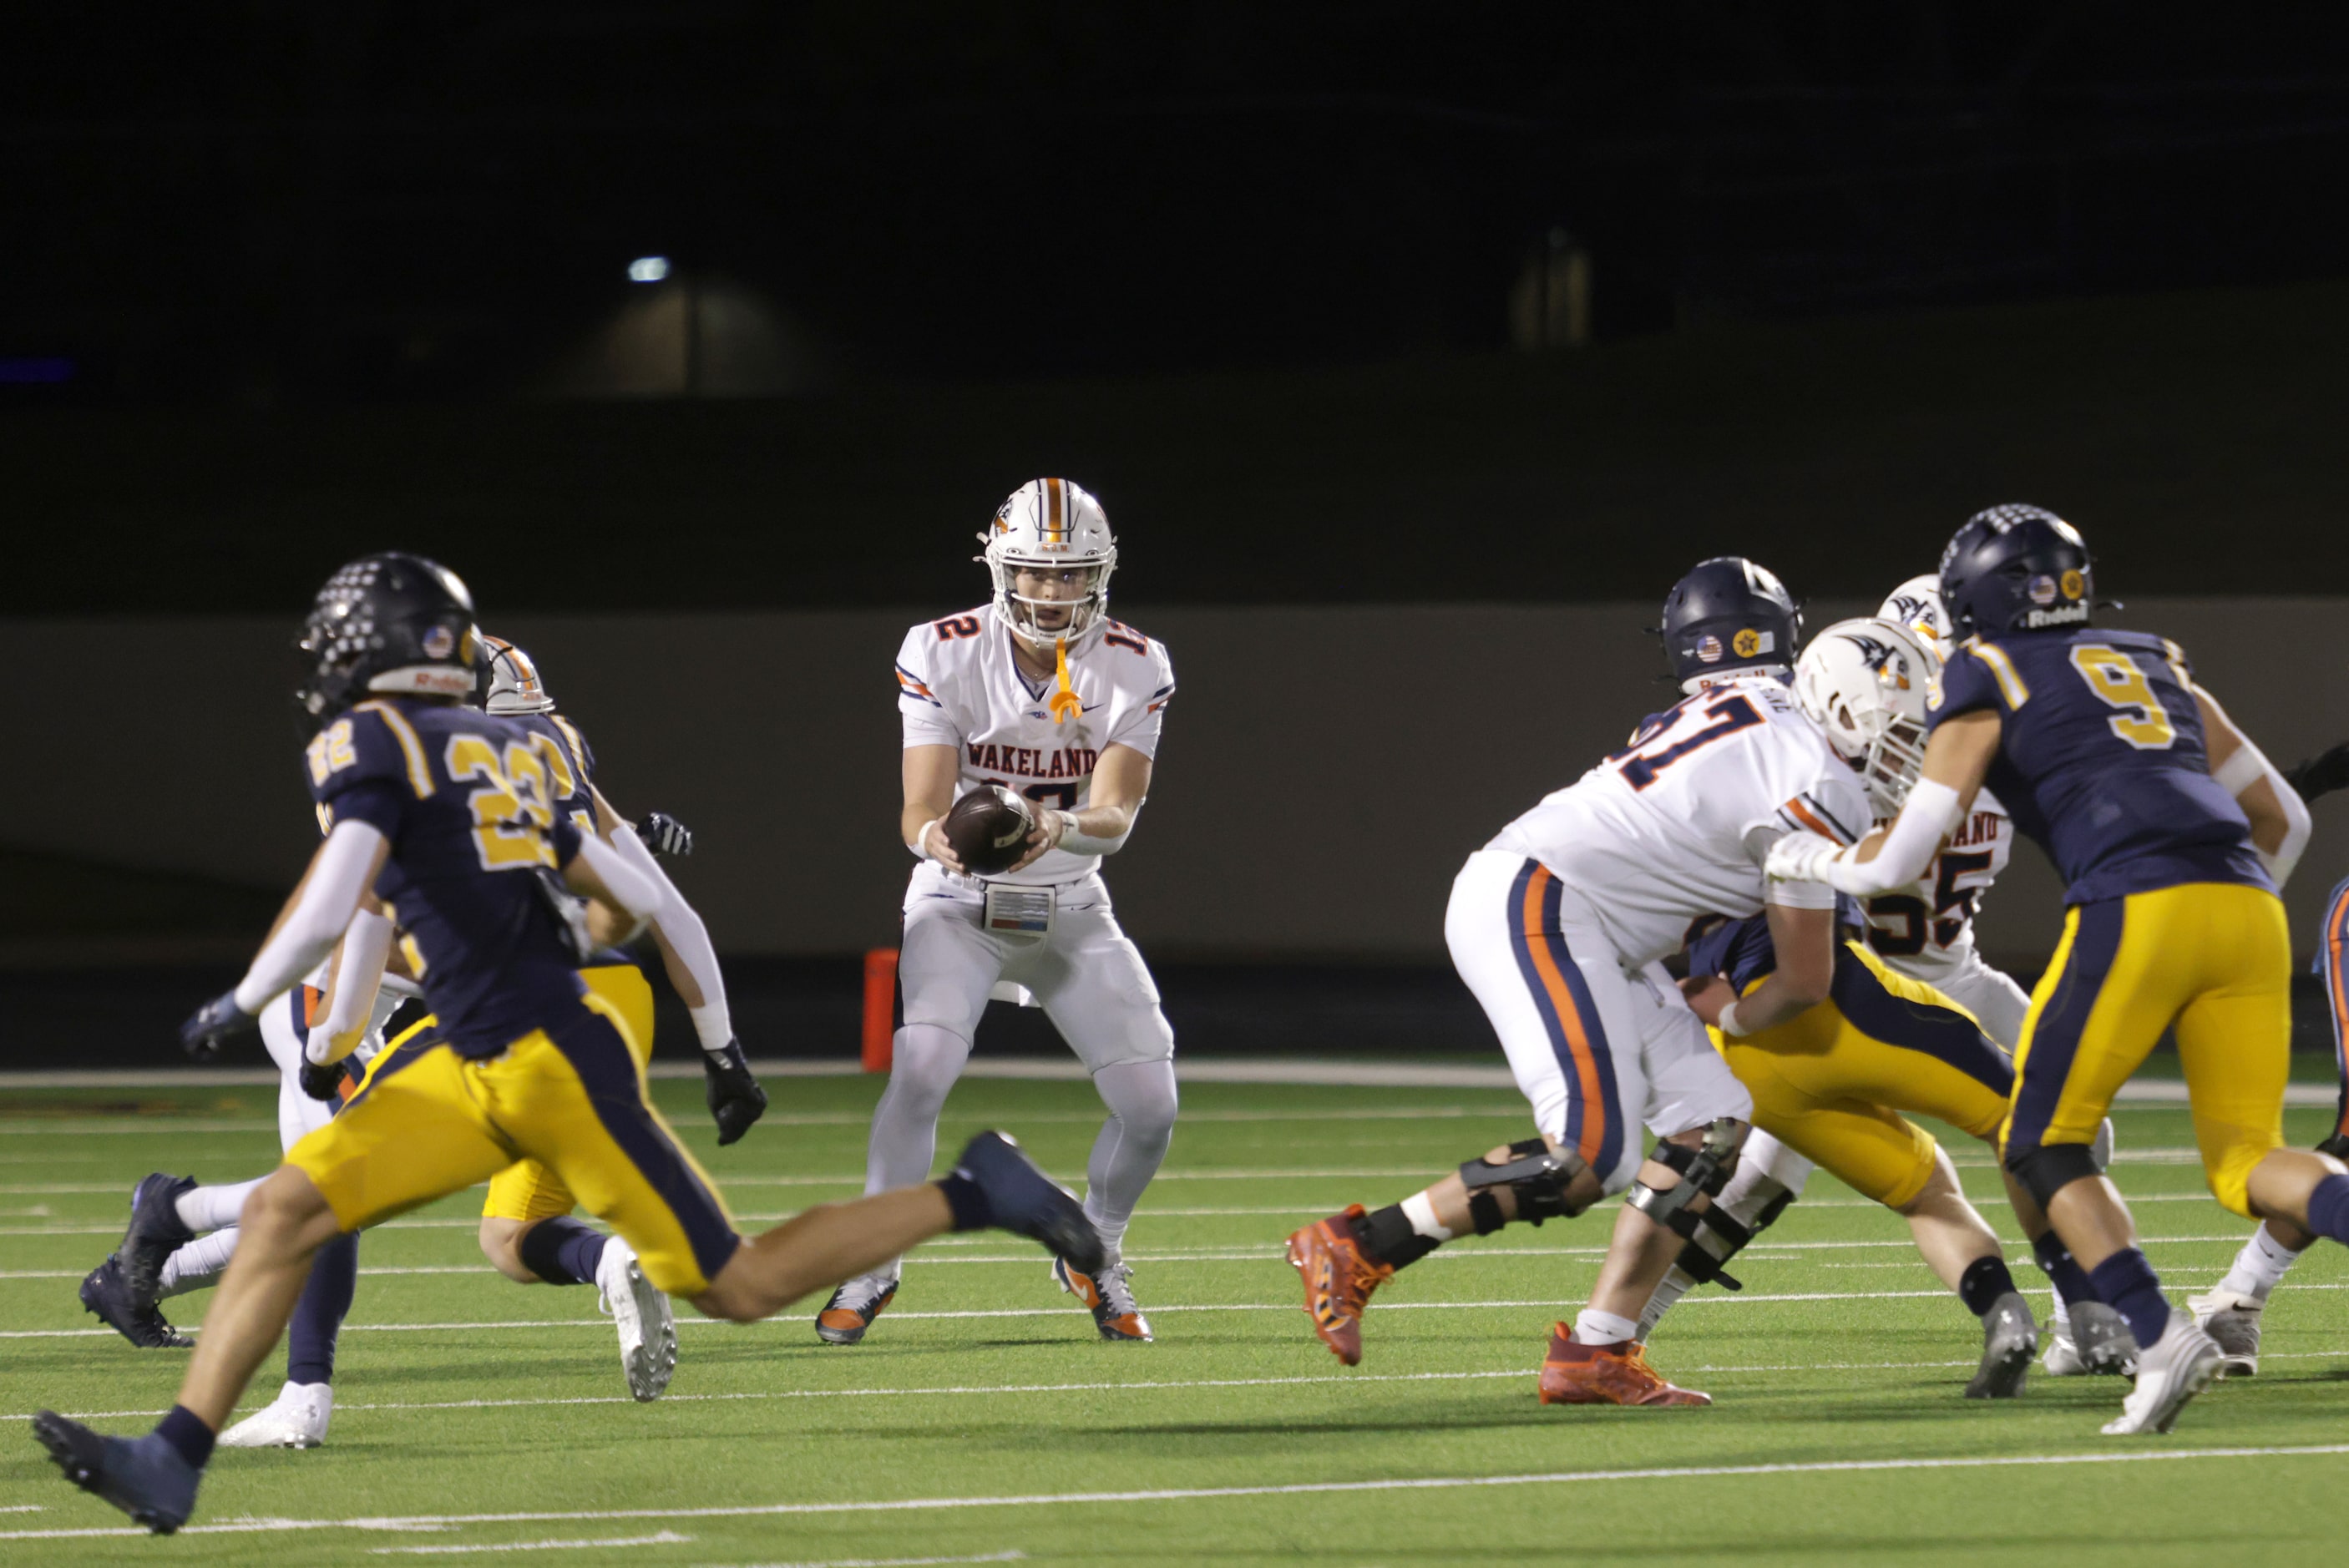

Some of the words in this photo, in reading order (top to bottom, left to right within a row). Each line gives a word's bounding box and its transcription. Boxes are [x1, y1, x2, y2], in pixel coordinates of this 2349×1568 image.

[932, 609, 982, 642] 2
[2069, 644, 2177, 750] 9
[306, 719, 357, 787] 22
[967, 742, 1098, 778] WAKELAND
[444, 734, 558, 871] 22
